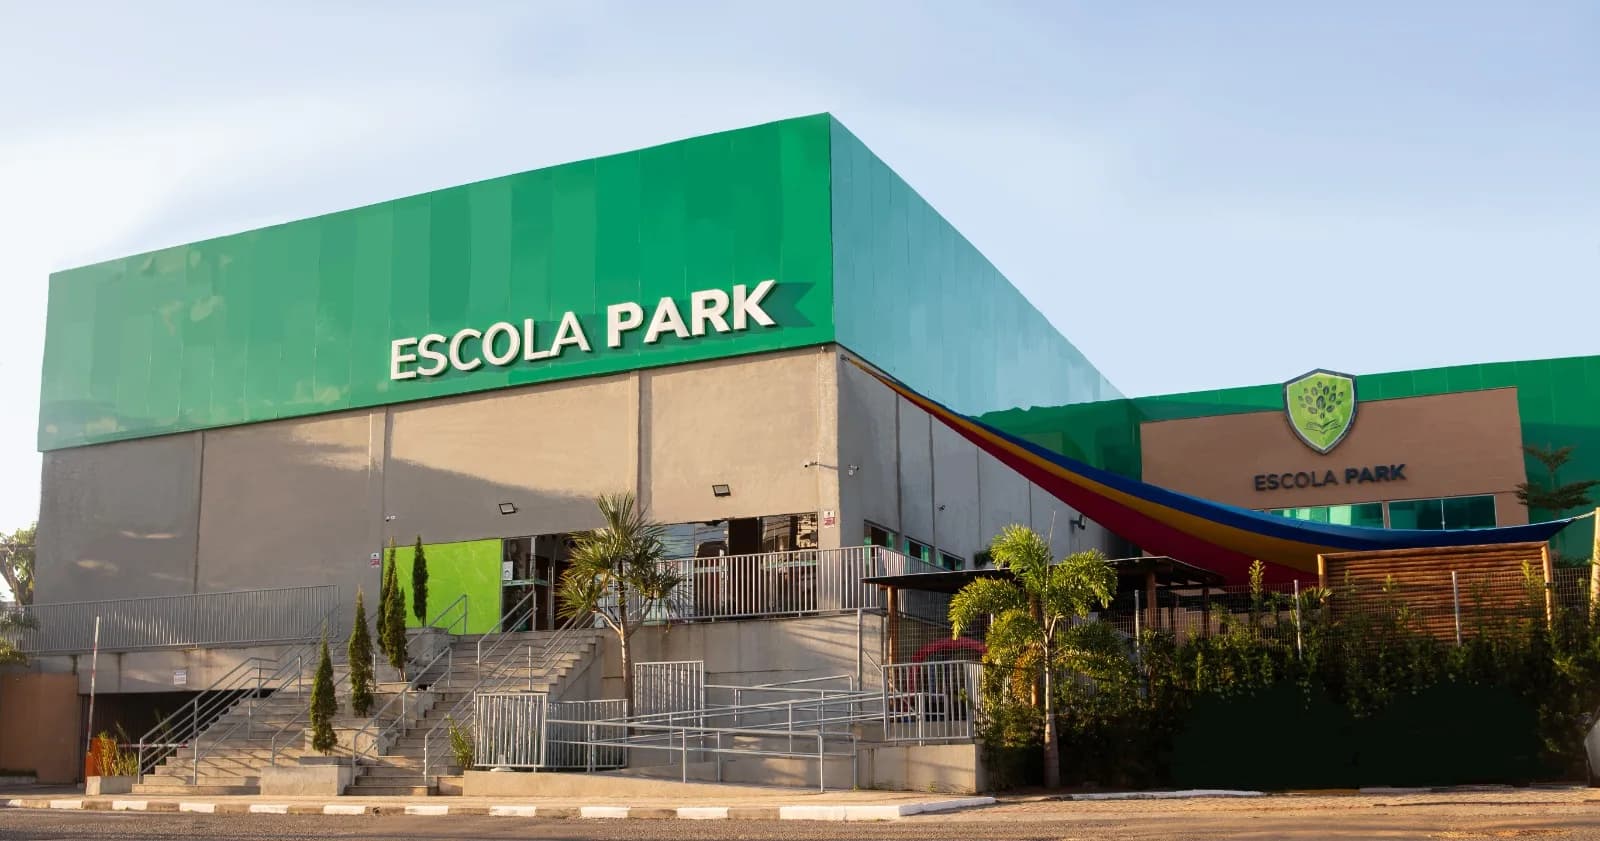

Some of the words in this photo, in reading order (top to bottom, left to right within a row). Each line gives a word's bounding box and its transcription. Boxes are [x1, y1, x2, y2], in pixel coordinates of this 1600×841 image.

[390, 311, 591, 381] ESCOLA
[607, 279, 777, 348] PARK
[1254, 470, 1338, 491] ESCOLA
[1345, 464, 1407, 485] PARK
